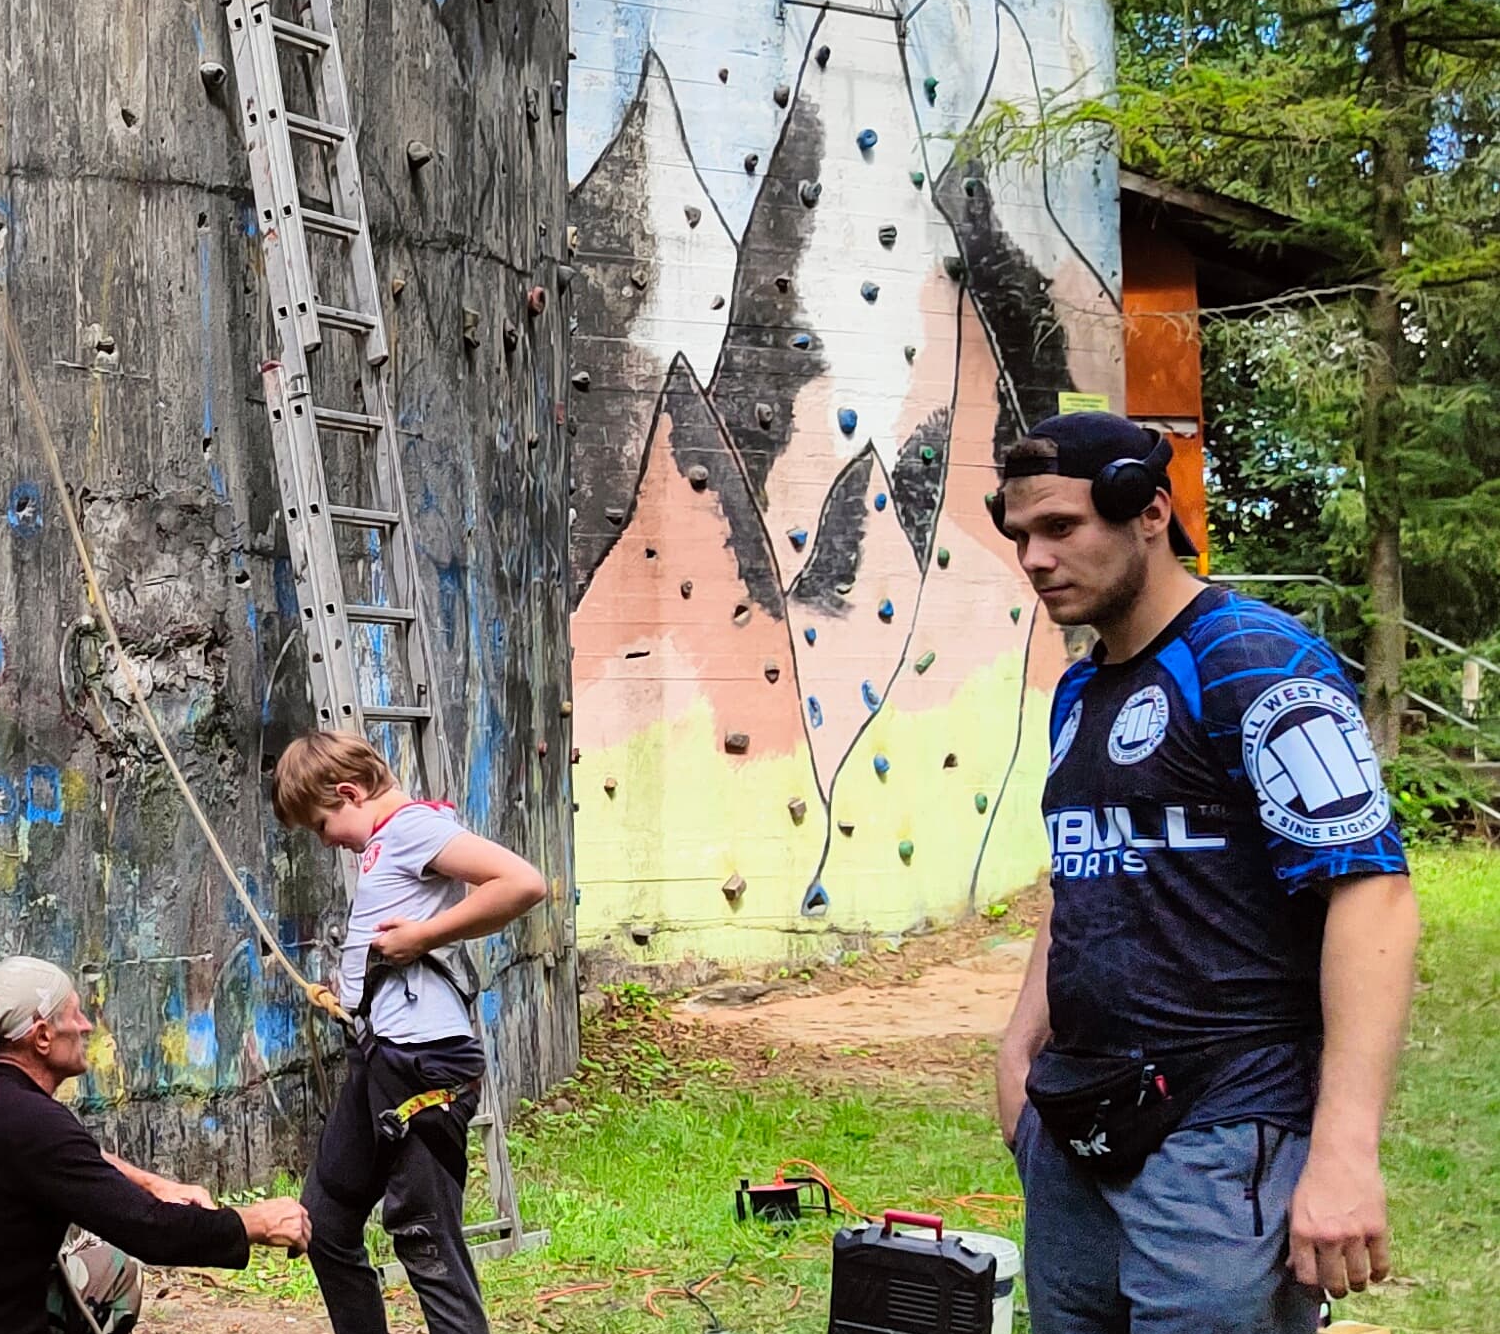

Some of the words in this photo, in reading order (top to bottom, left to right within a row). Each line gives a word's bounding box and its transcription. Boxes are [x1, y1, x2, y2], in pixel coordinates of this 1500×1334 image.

[1263, 685, 1323, 713] WEST
[1278, 816, 1321, 839] SINCE
[1329, 808, 1382, 838] EIGHTY
